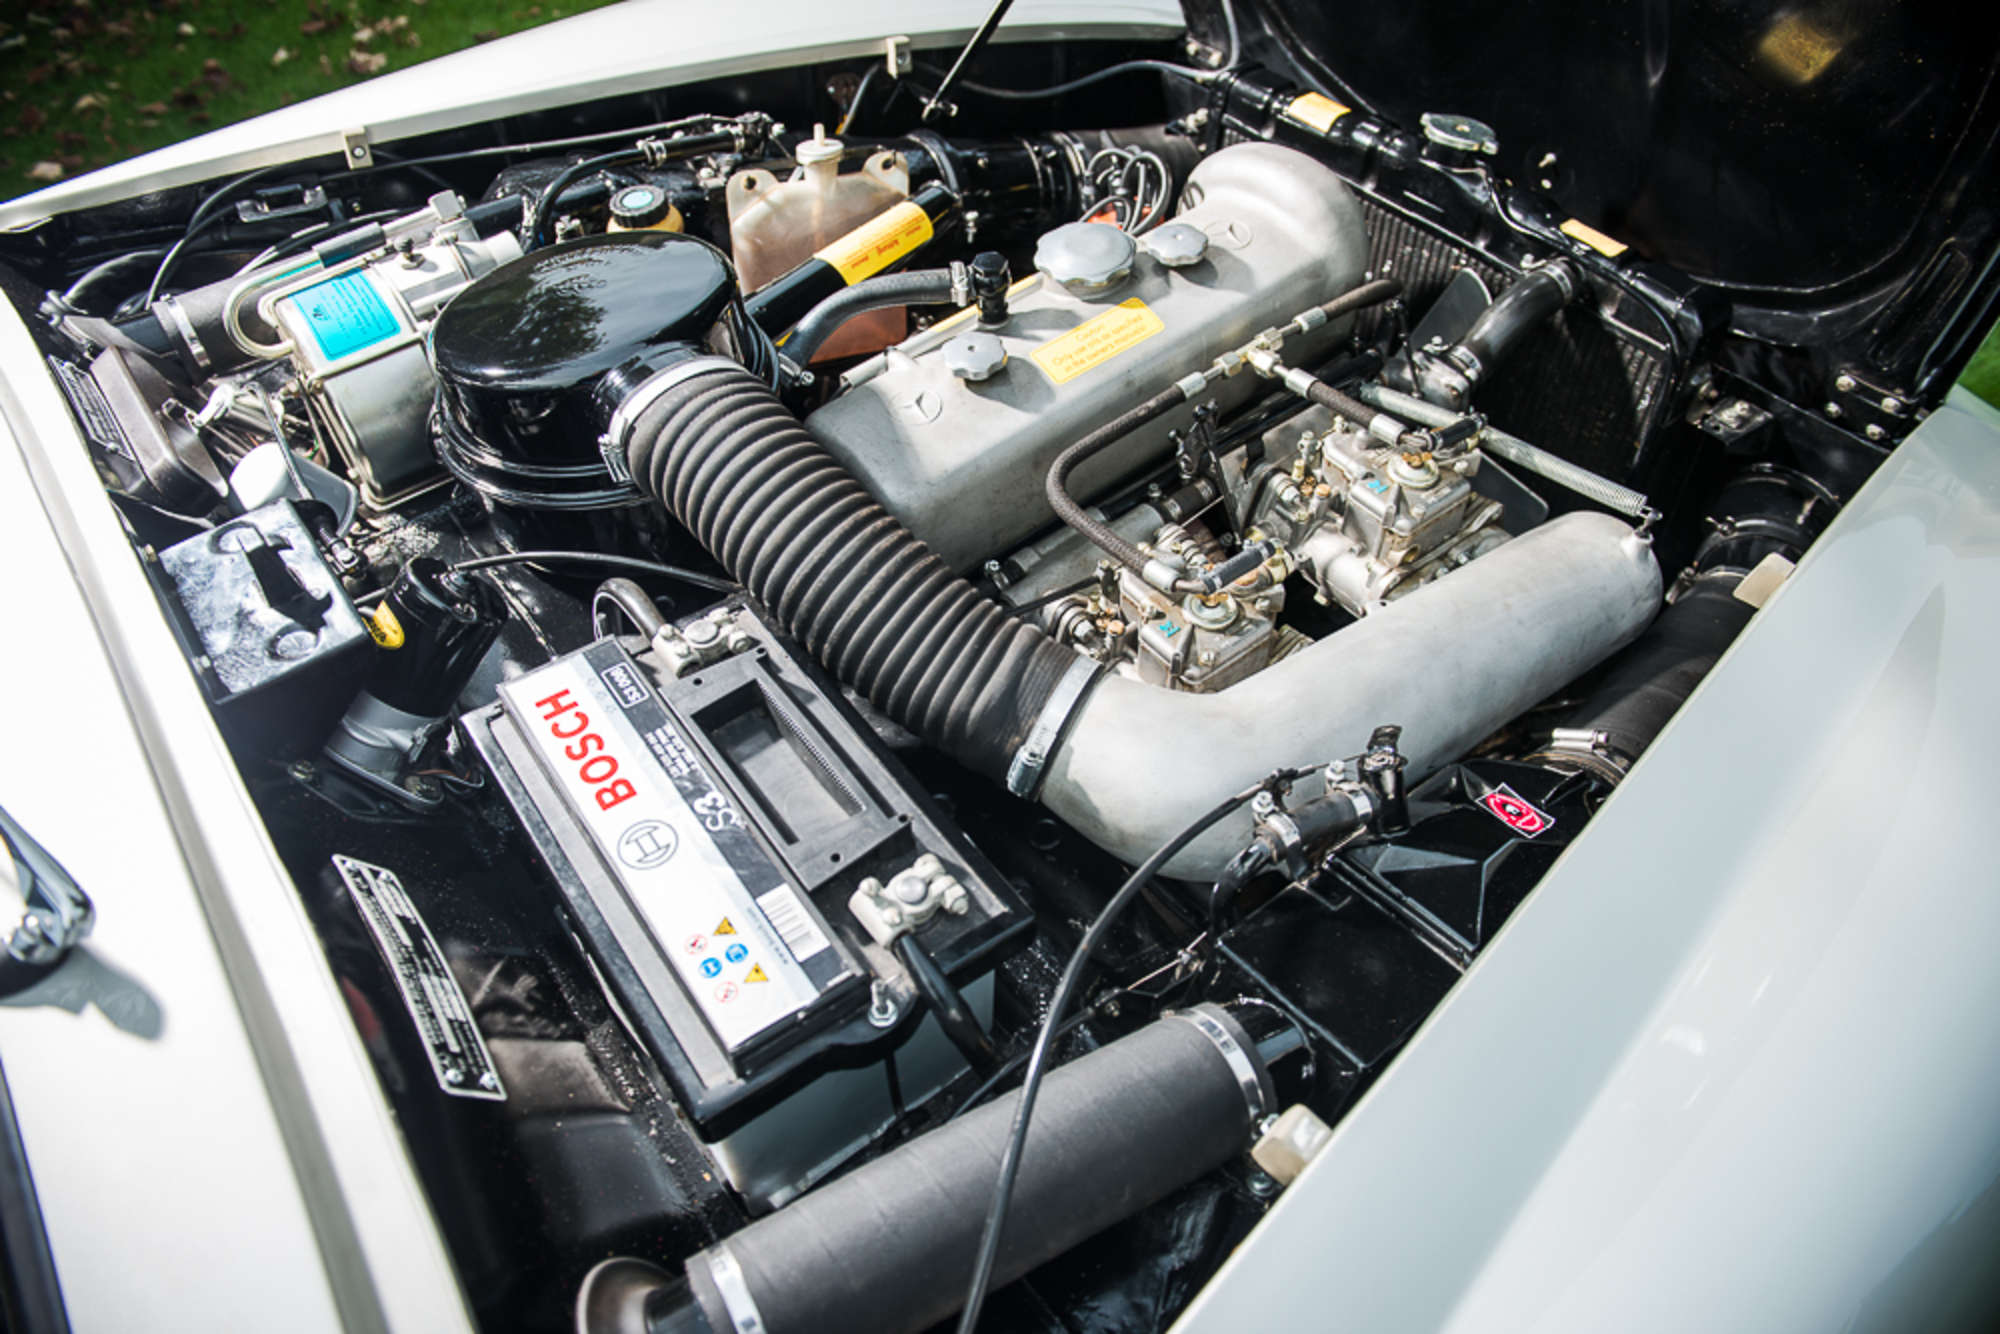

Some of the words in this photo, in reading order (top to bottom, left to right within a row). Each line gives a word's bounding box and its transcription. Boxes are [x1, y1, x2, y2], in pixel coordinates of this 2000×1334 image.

[623, 686, 641, 702] S3
[535, 689, 637, 811] BOSCH
[693, 791, 737, 831] S3
